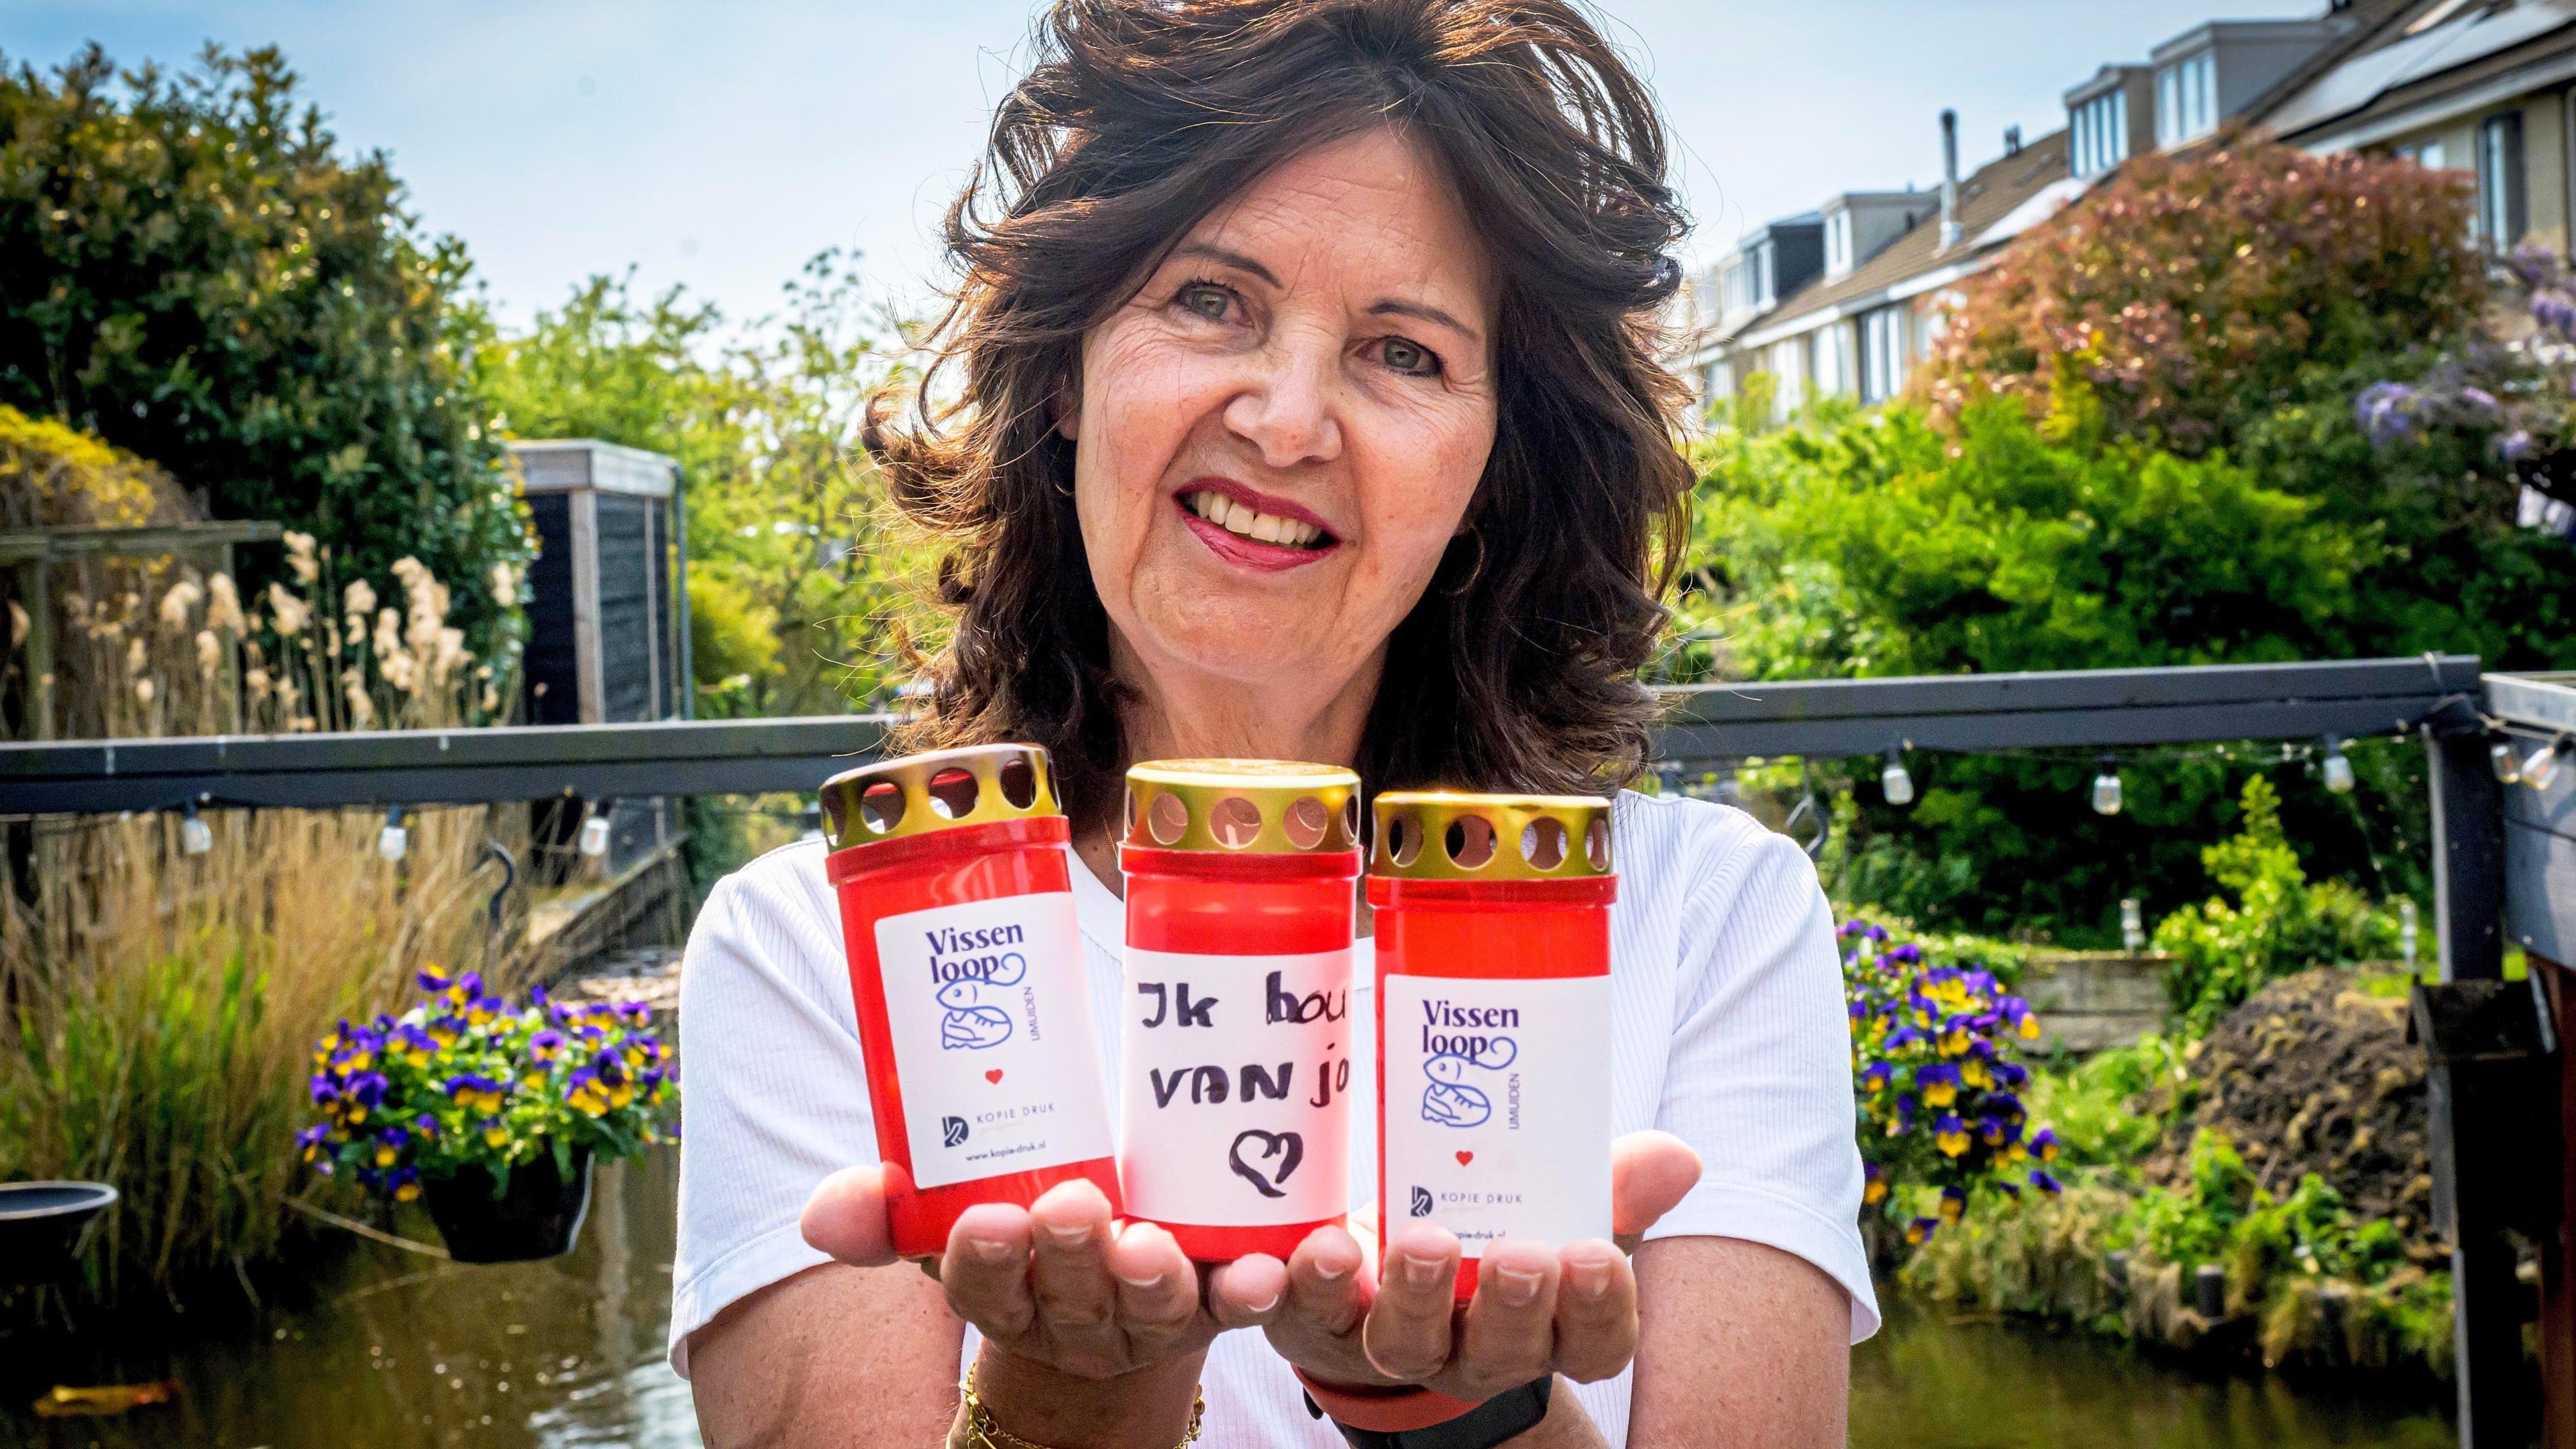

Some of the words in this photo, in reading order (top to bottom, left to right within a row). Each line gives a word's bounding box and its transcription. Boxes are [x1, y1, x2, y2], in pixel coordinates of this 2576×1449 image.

[925, 924, 1024, 955] Vissen
[930, 955, 999, 985] loop
[1266, 971, 1346, 1025] hou
[1422, 1000, 1518, 1027] Vissen
[1423, 1024, 1487, 1065] loop
[976, 1109, 1015, 1124] KOPIE
[1022, 1103, 1055, 1116] DRUK
[966, 1140, 1046, 1161] www.kopie-druk.nl
[1441, 1192, 1479, 1203] KOPIE
[1487, 1193, 1522, 1204] DRUK
